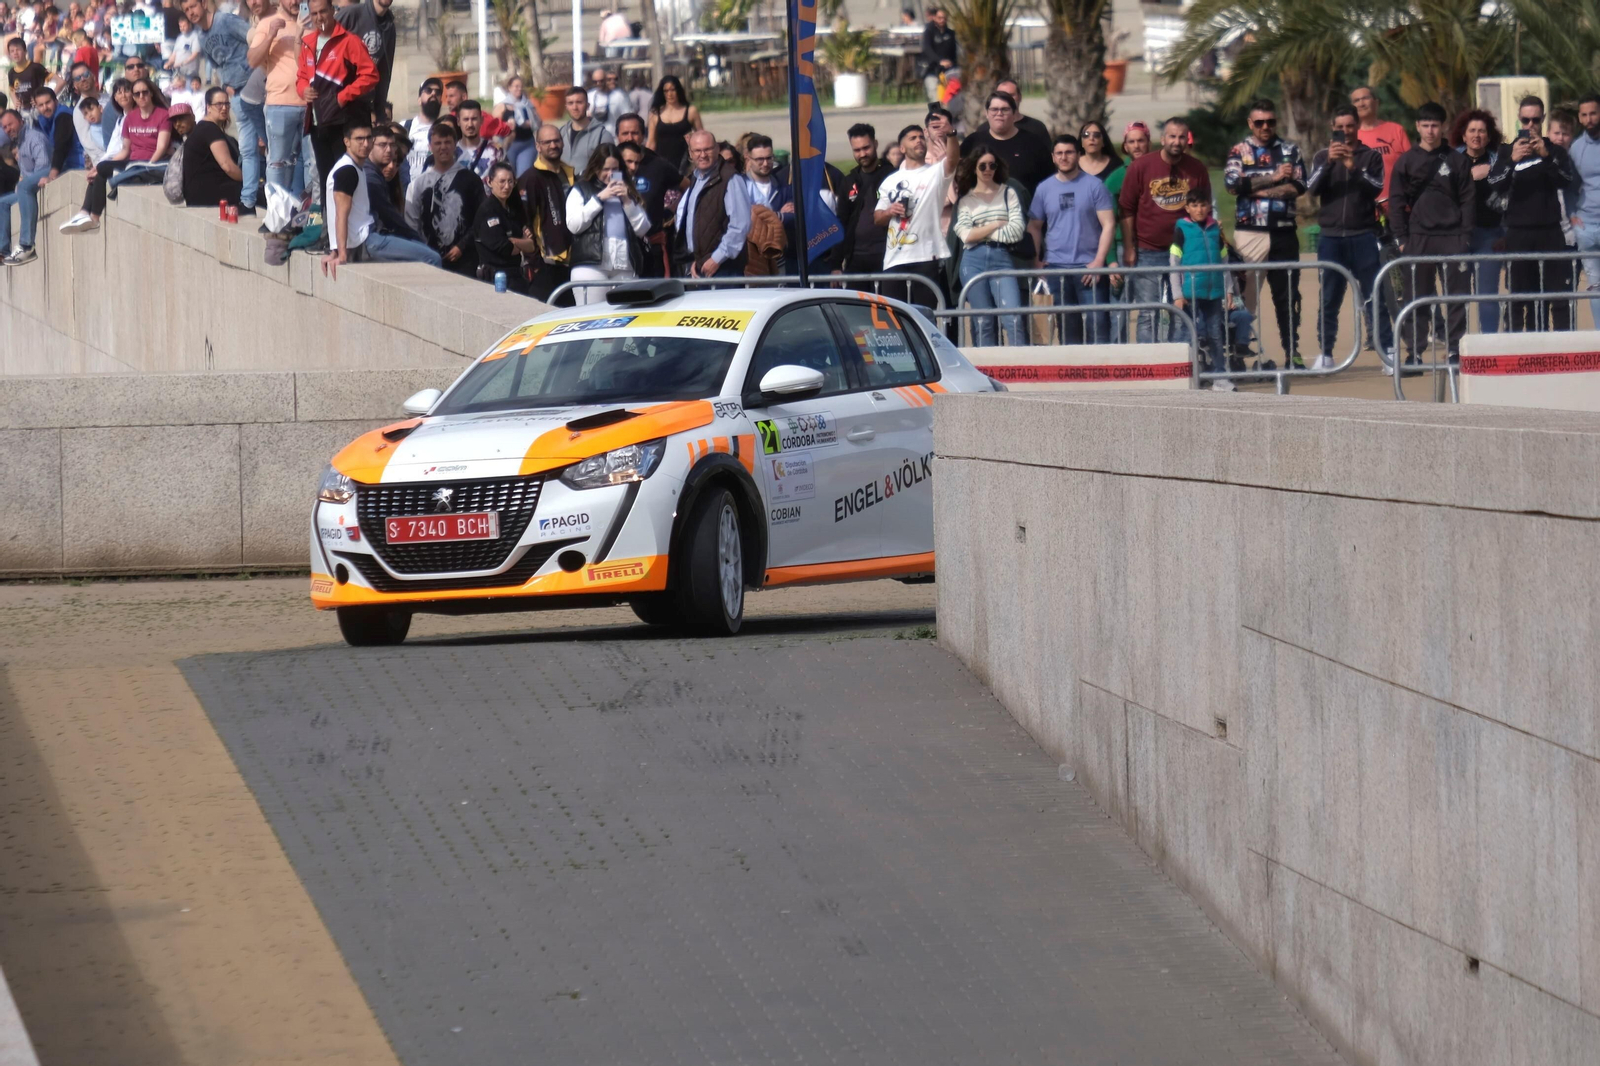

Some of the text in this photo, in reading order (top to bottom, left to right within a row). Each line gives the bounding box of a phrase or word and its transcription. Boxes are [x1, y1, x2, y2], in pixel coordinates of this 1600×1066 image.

[676, 316, 741, 331] ESPAÑOL
[1518, 356, 1570, 368] CARRETERA
[998, 367, 1039, 380] CORTADA
[1057, 367, 1110, 380] CARRETERA
[1113, 367, 1155, 379] CORTADA
[757, 420, 781, 455] 21
[782, 434, 816, 449] CÓRDOBA
[835, 480, 884, 523] ENGEL
[885, 474, 895, 499] &
[552, 513, 590, 528] PAGID
[771, 506, 801, 521] COBIAN
[408, 520, 446, 537] 7340
[457, 518, 487, 535] BCH
[540, 524, 592, 538] RACING
[587, 562, 644, 582] PIRELLI
